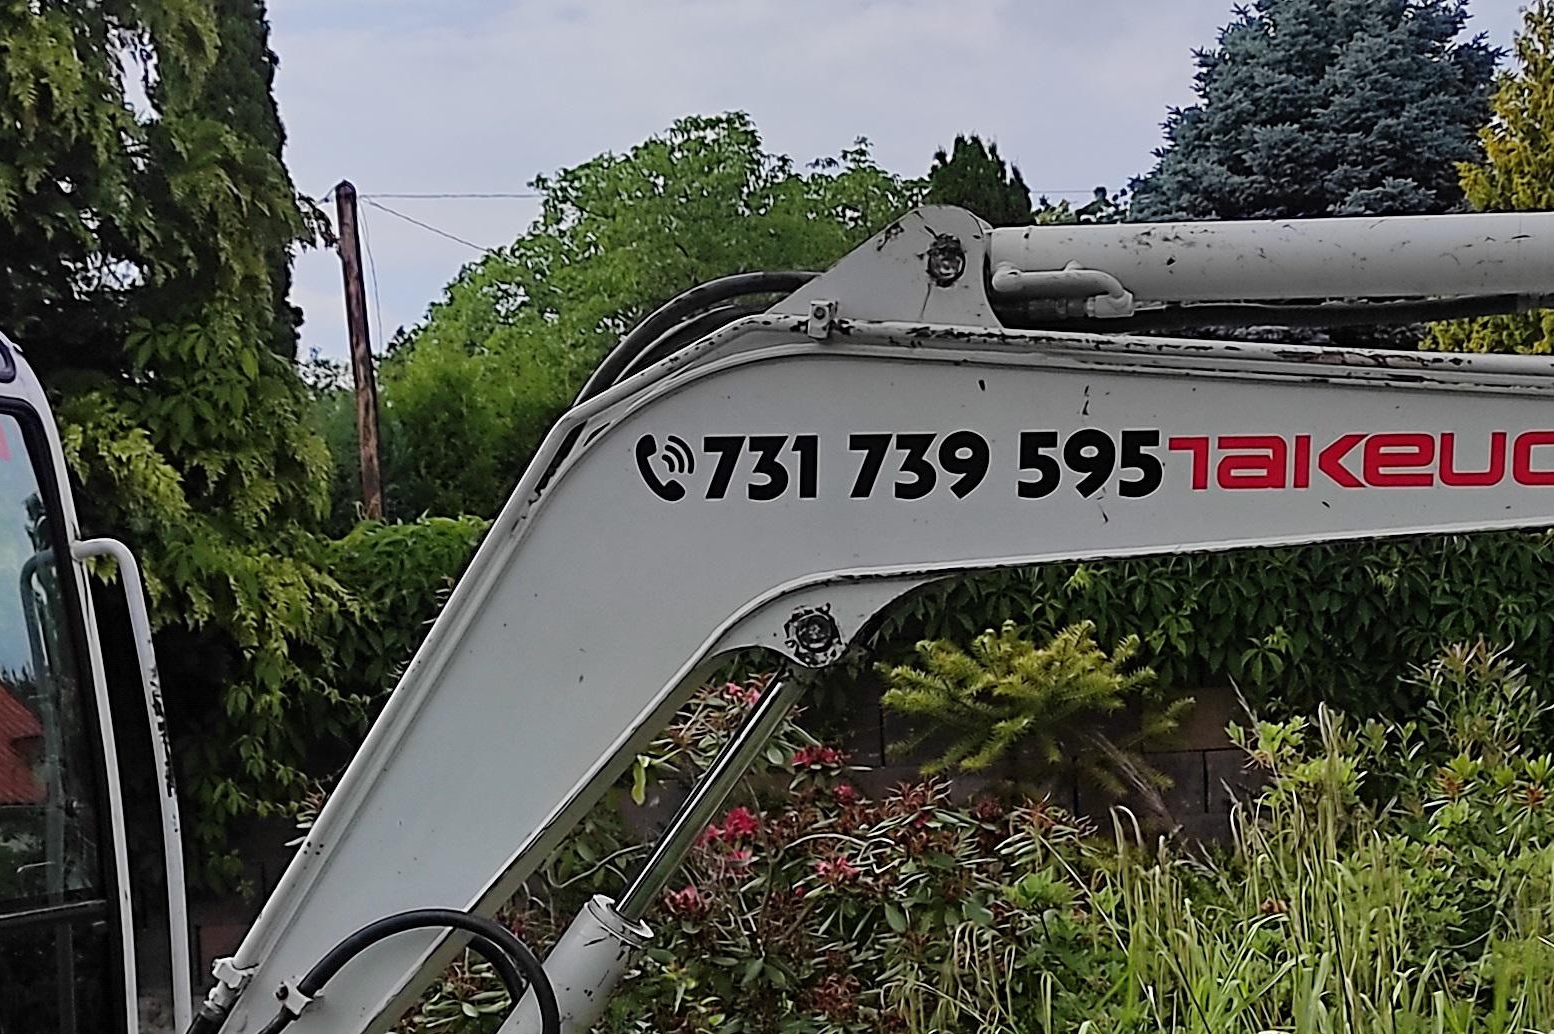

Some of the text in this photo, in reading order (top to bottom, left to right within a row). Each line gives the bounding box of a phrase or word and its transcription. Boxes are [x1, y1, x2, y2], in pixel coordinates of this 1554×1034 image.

[703, 434, 819, 501] 731
[848, 430, 990, 501] 739
[1017, 428, 1164, 500] 595
